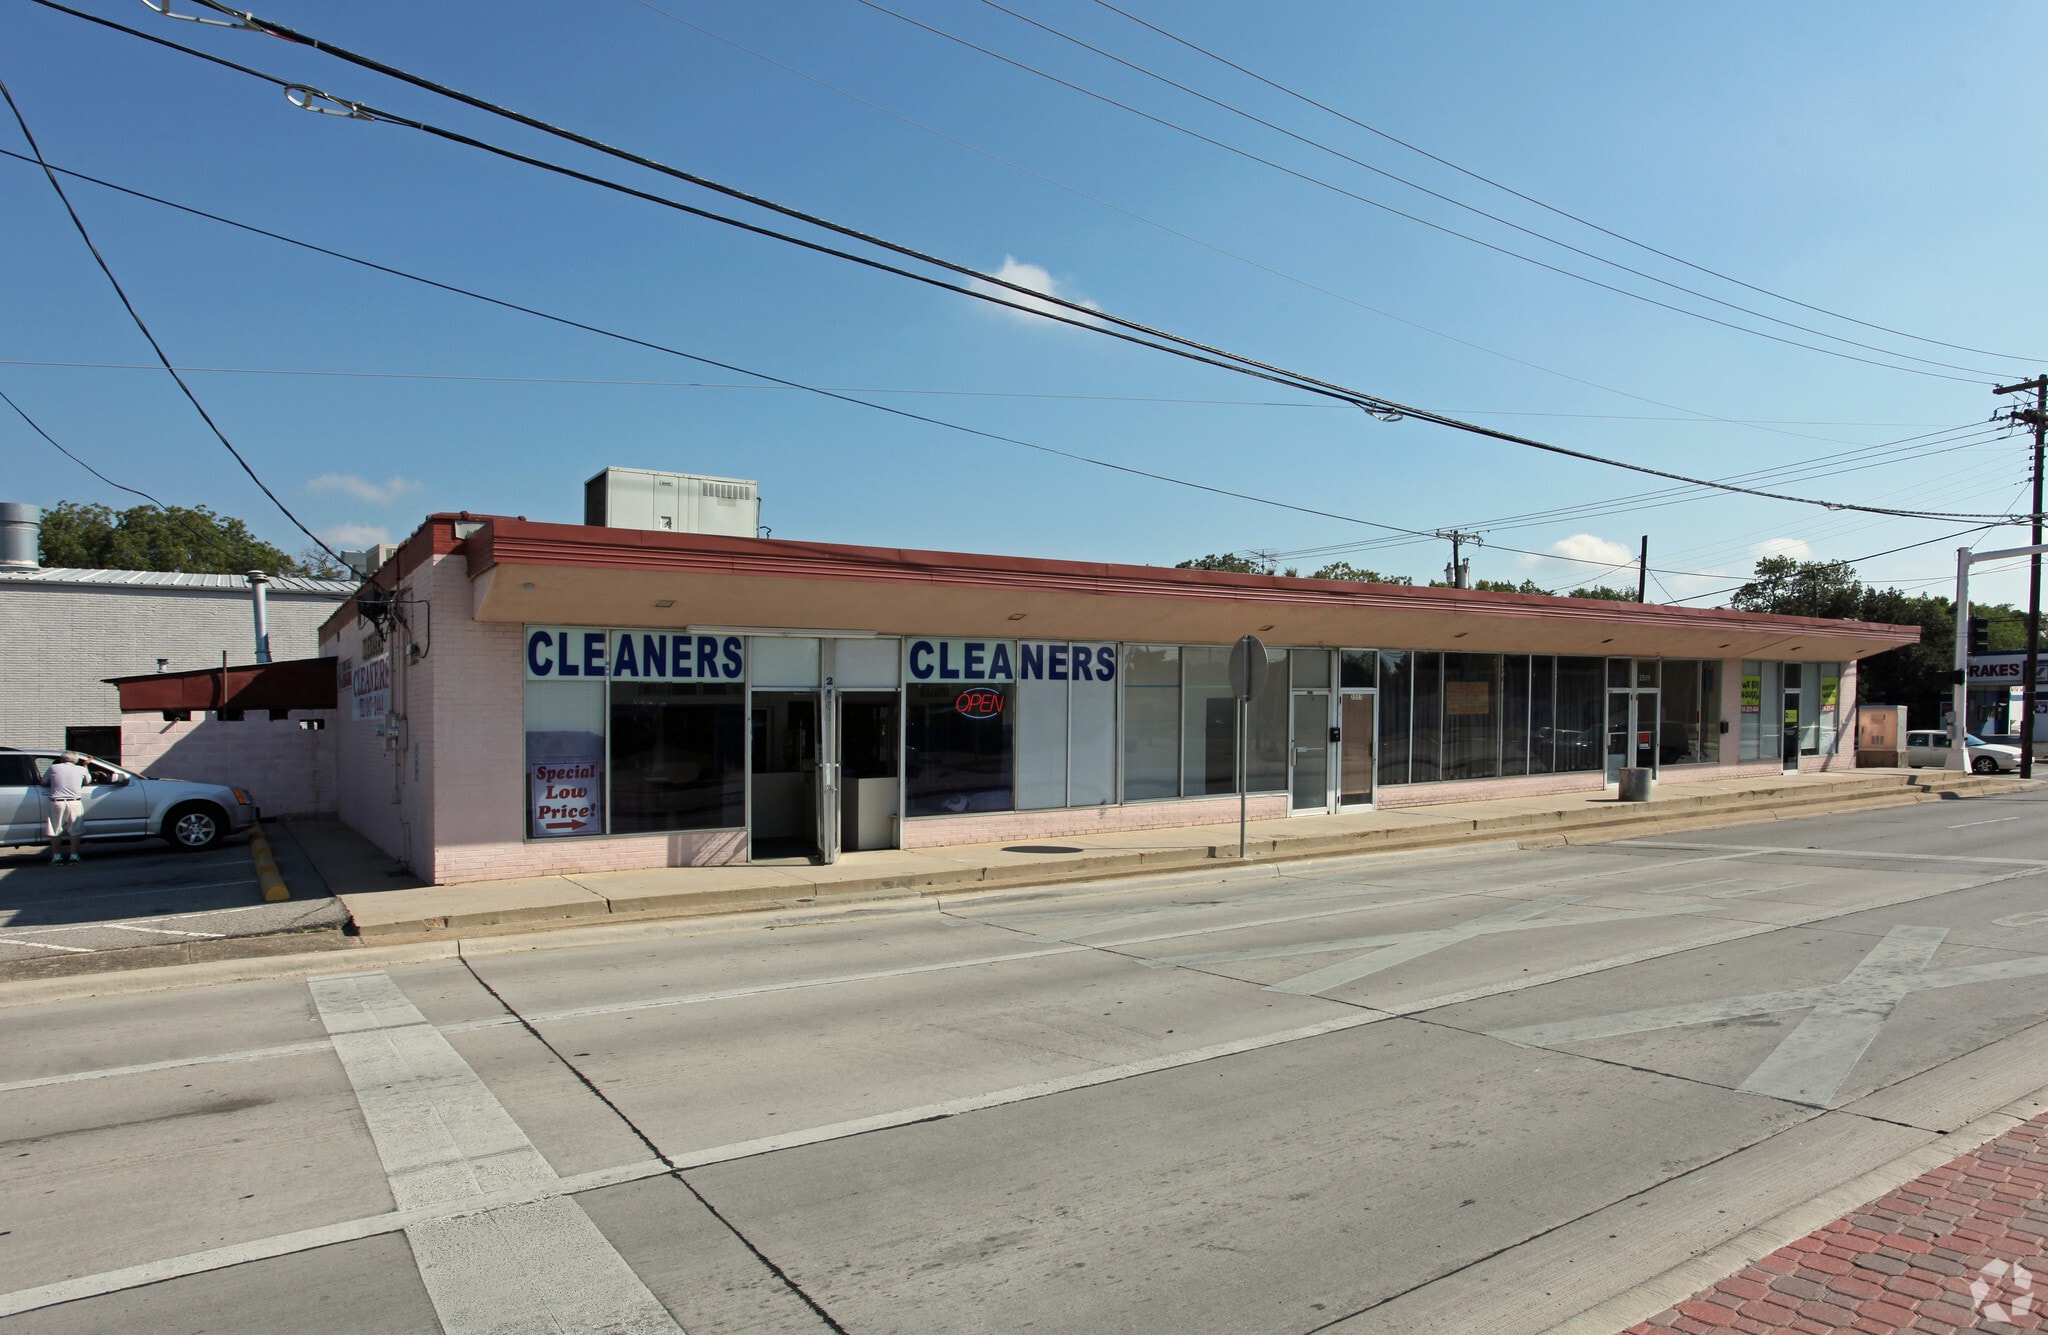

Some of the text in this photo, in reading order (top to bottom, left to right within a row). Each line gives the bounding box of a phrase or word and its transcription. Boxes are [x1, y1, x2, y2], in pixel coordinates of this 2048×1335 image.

[528, 631, 743, 678] CLEANERS
[910, 641, 1115, 681] CLEANERS
[1966, 663, 2020, 677] RAKES
[956, 693, 1005, 713] OPEN
[536, 764, 596, 783] Special
[545, 785, 588, 800] Low
[537, 803, 596, 820] Price!
